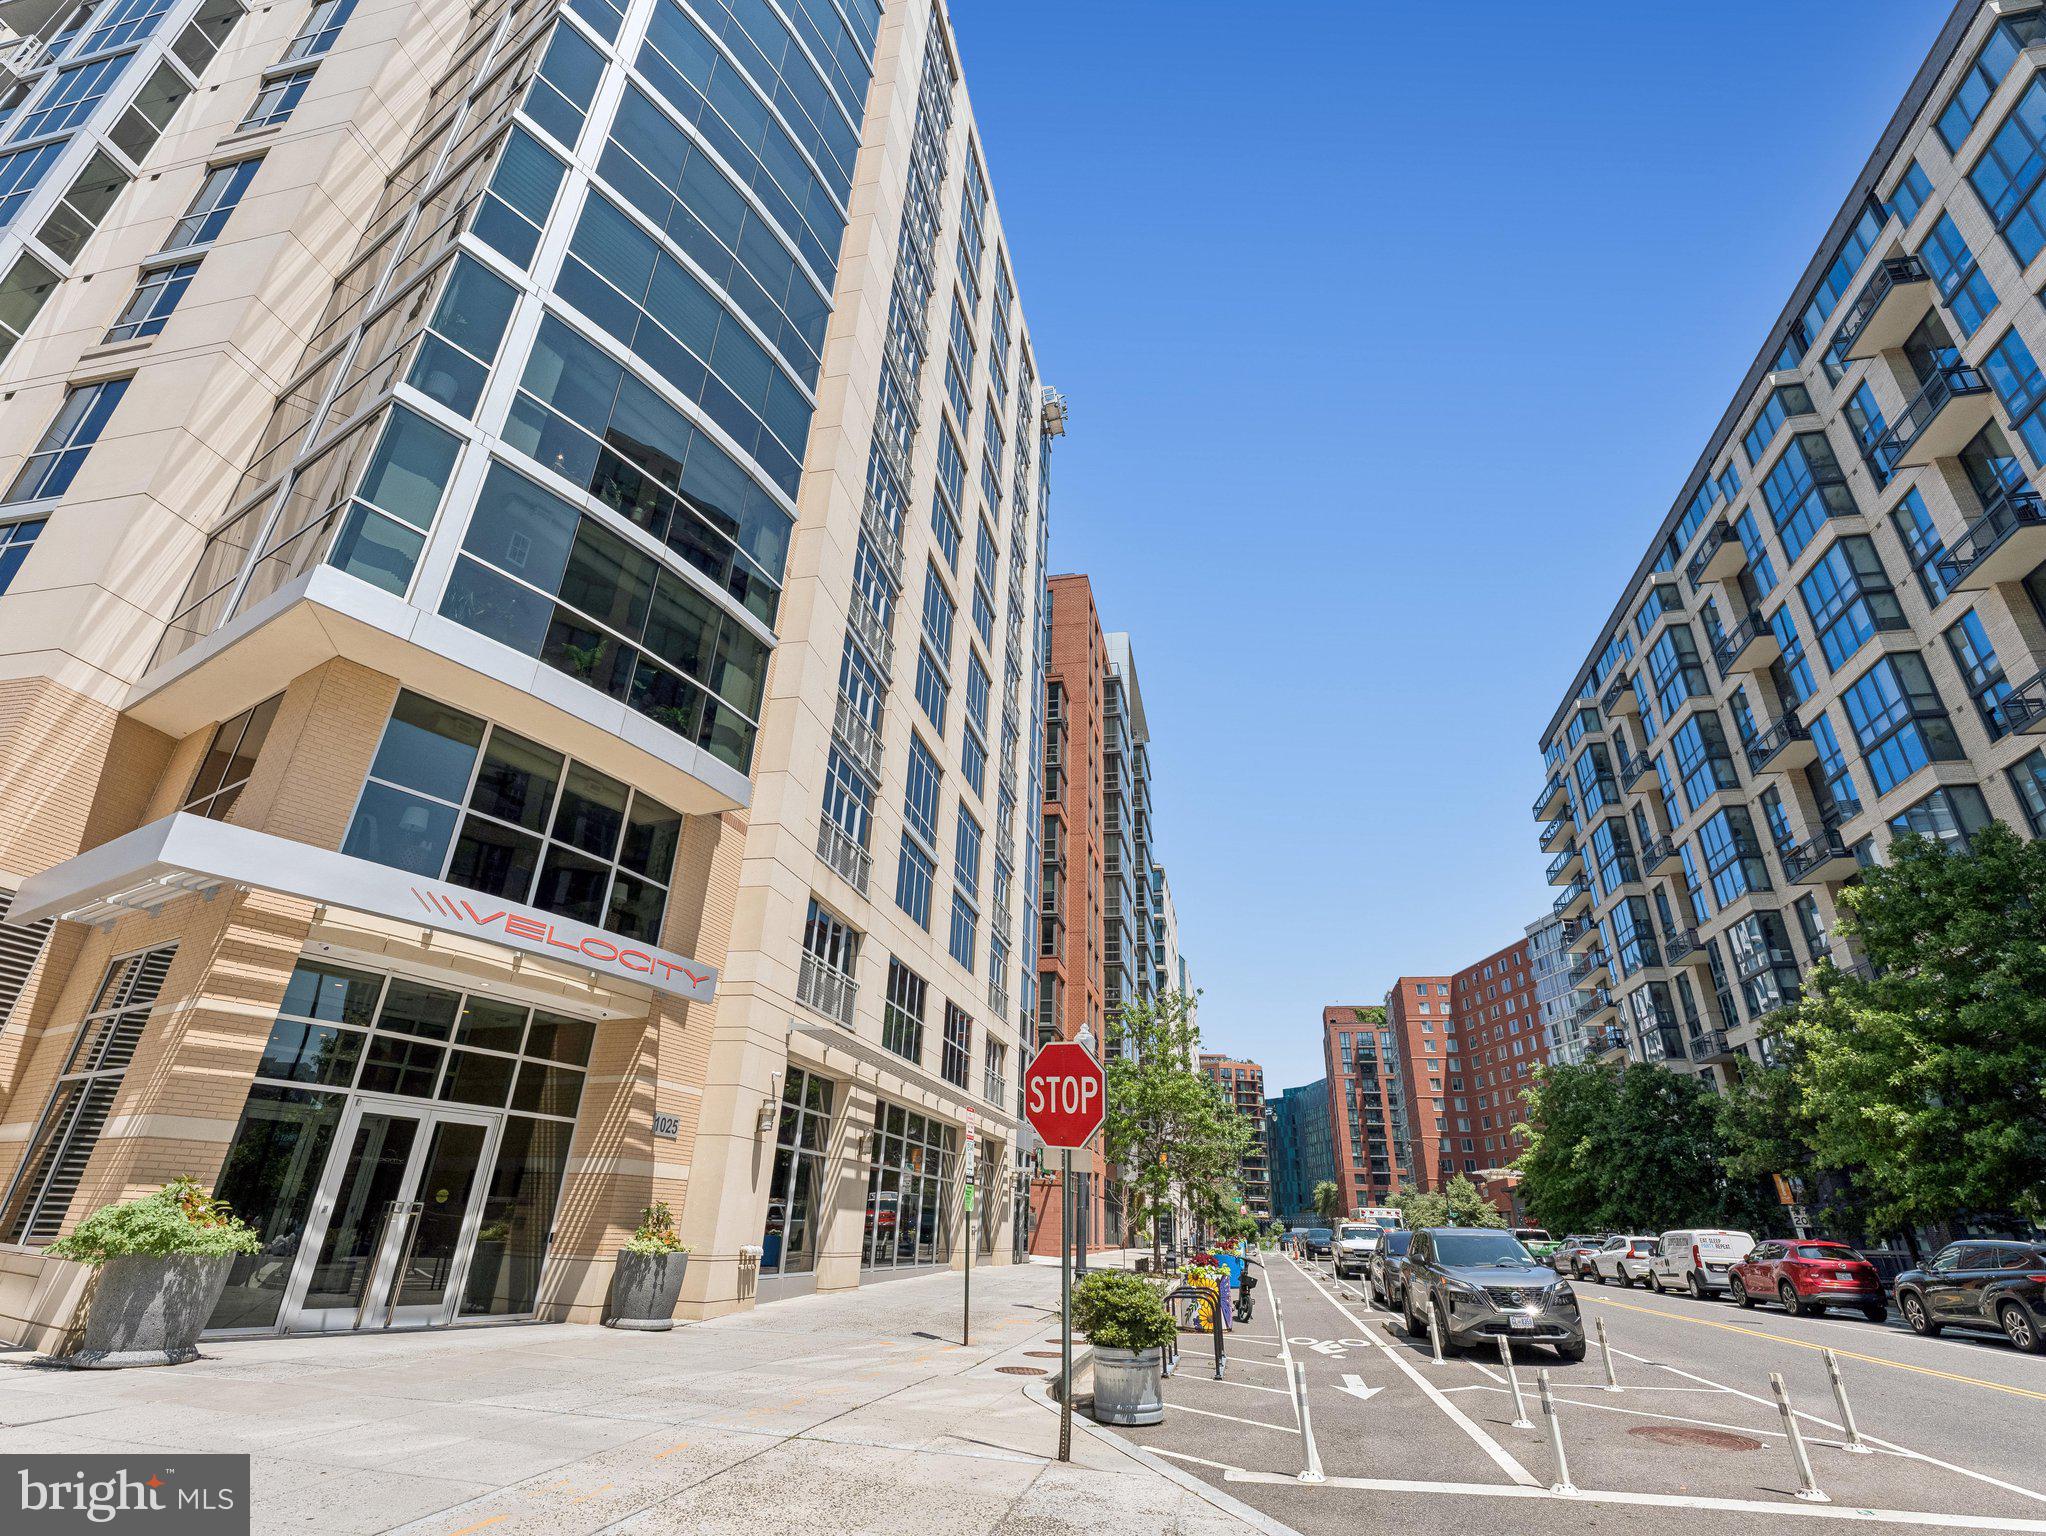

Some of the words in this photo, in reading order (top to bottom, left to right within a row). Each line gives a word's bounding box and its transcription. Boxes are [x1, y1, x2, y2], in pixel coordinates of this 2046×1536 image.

[460, 899, 711, 990] VELOCITY
[1029, 1075, 1099, 1115] STOP
[654, 1116, 678, 1134] 1025
[1793, 1216, 1809, 1225] 20
